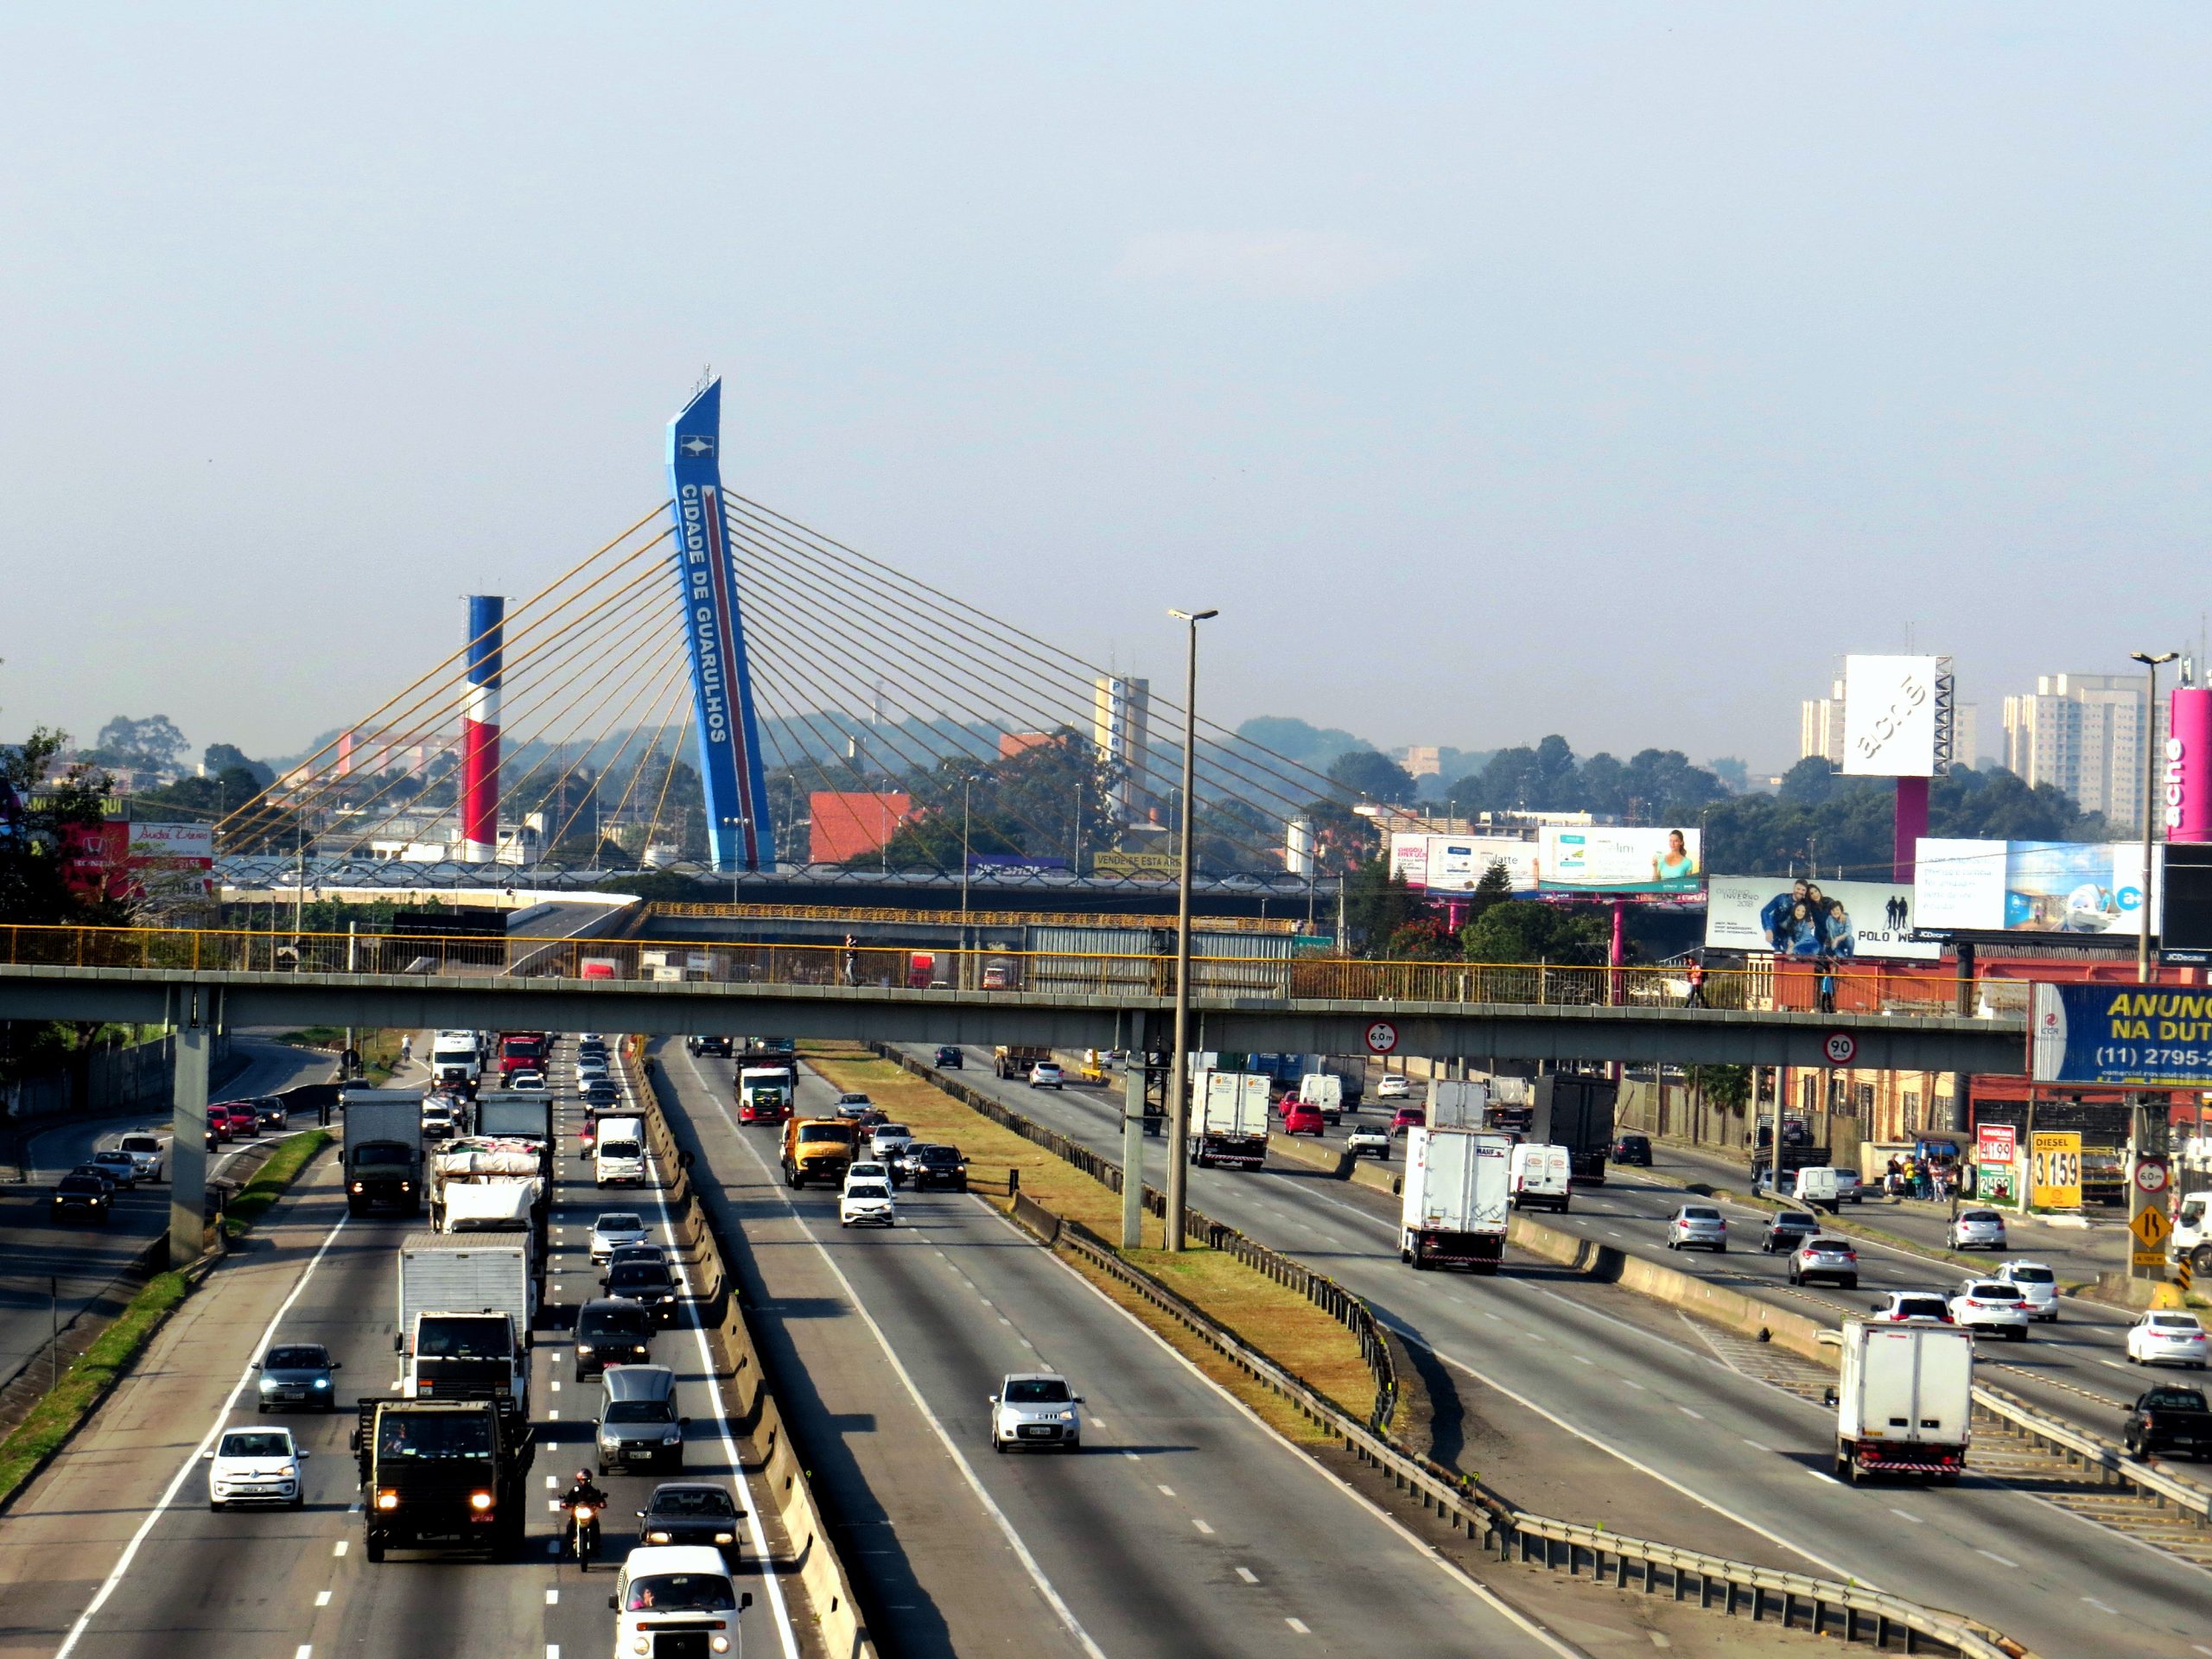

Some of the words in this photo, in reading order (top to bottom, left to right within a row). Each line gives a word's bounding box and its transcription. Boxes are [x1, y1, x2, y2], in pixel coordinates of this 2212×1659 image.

[682, 483, 705, 564] CIDADE
[692, 570, 709, 601] DE
[696, 610, 727, 744] GUARULHOS
[1141, 857, 1161, 866] ESTA
[1858, 931, 1890, 942] POLO
[2166, 953, 2206, 962] JCDecaux
[1370, 1033, 1385, 1041] 6,0
[2111, 1020, 2151, 1039] NA
[2159, 1021, 2212, 1042] DUT
[1831, 1040, 1850, 1053] 90
[2096, 1046, 2138, 1067] (11)
